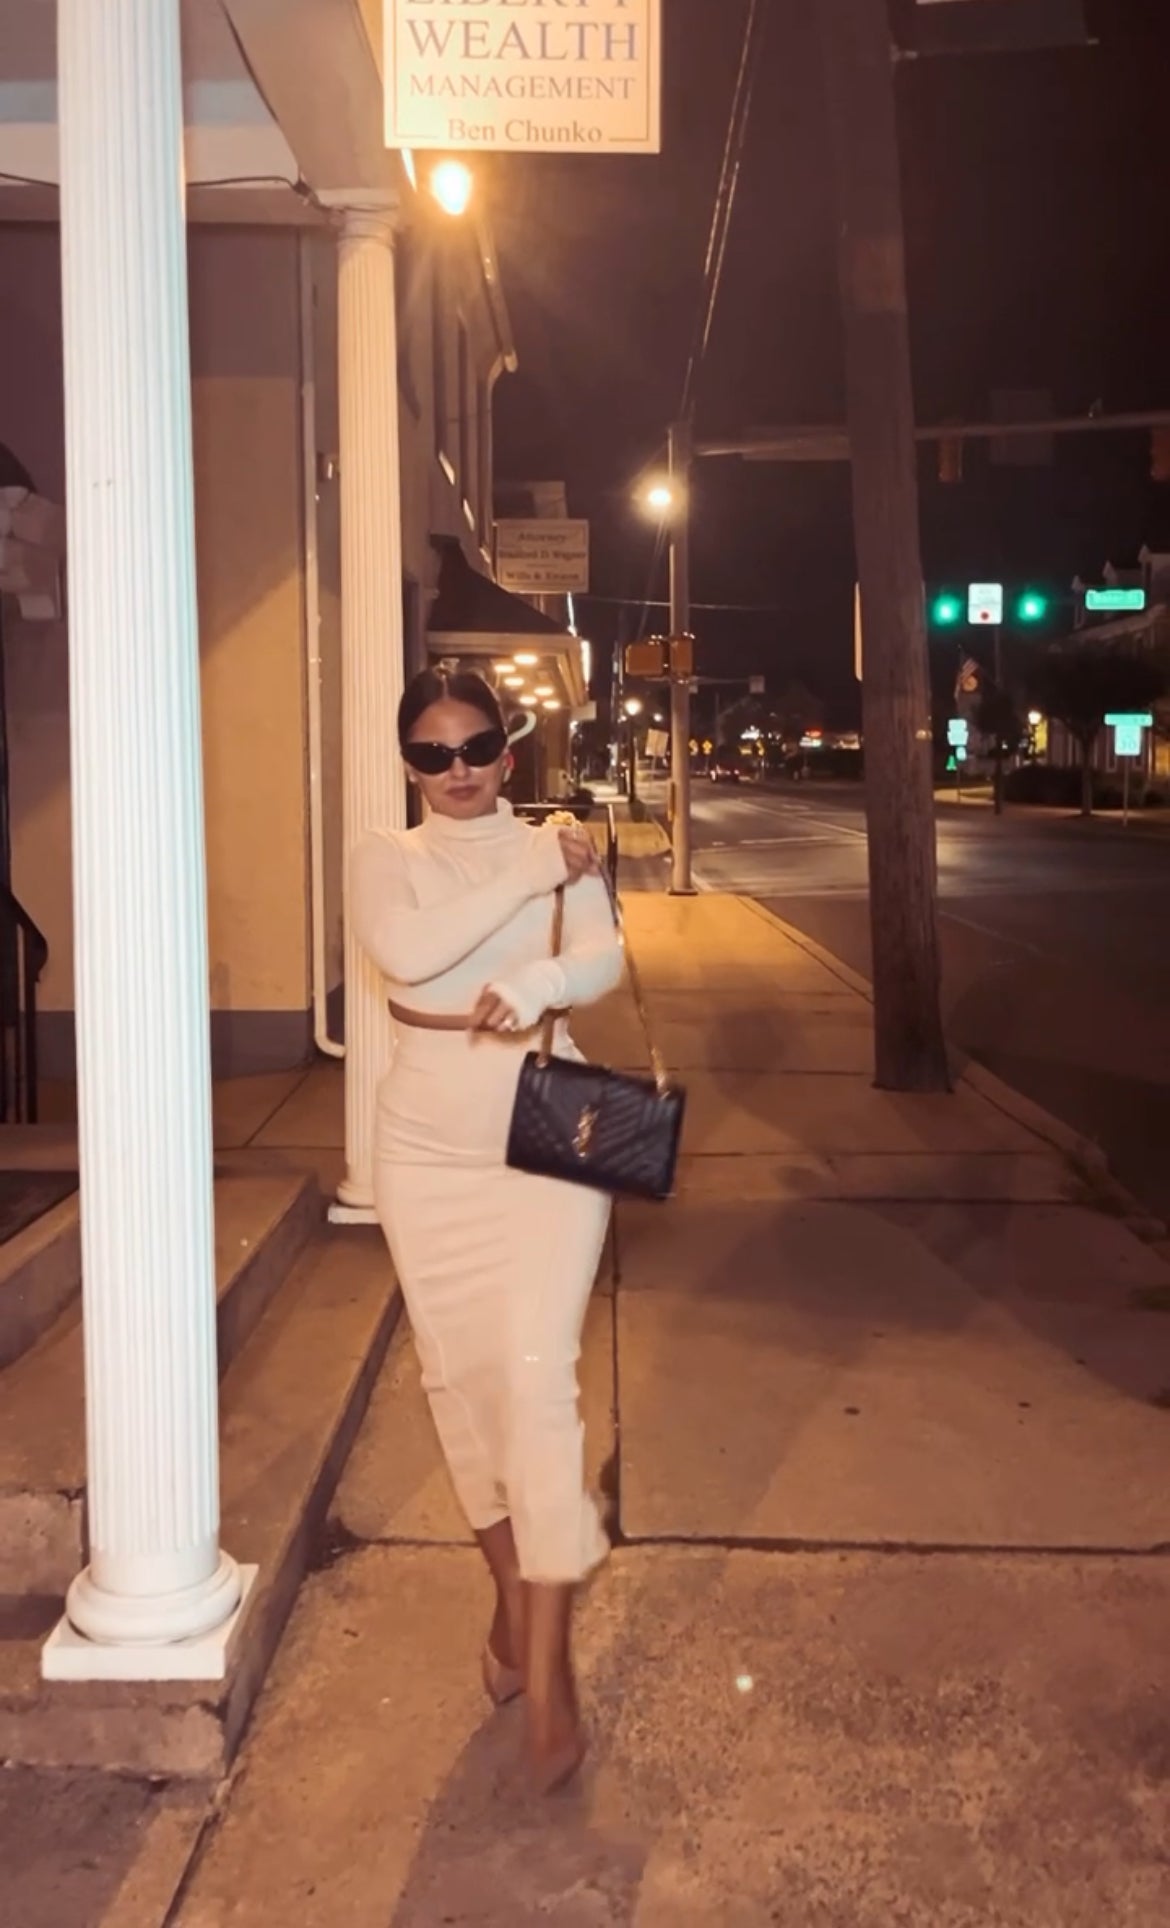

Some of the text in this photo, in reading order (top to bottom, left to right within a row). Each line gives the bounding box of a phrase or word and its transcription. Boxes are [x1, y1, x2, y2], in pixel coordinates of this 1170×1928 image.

[406, 19, 639, 61] WEALTH
[409, 74, 636, 100] MANAGEMENT
[448, 118, 603, 143] Ben Chunko
